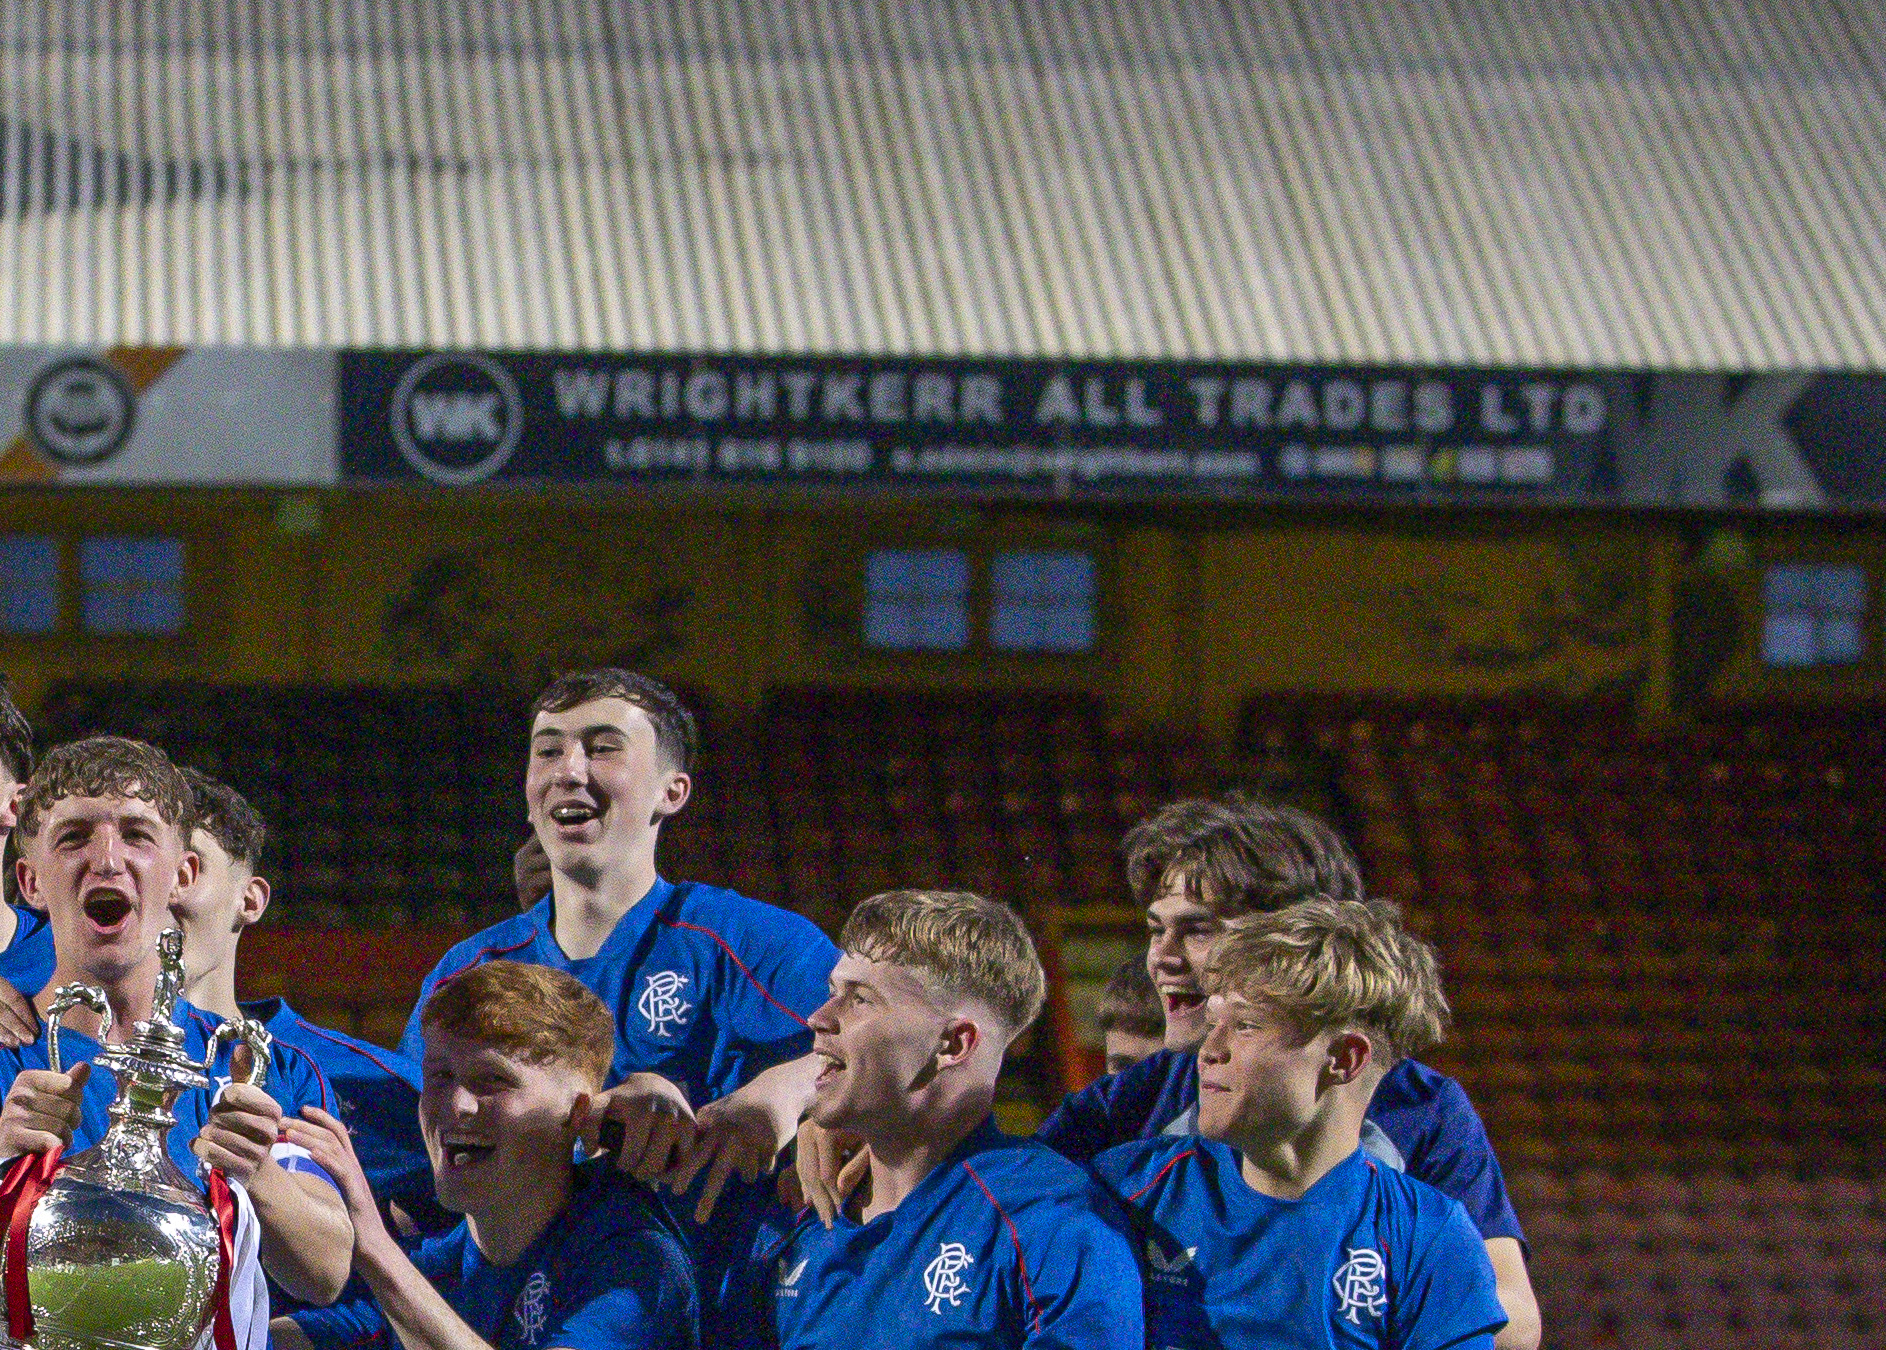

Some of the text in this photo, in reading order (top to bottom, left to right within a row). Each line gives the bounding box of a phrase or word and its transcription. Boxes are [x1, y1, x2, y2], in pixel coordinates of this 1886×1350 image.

[554, 368, 1606, 434] WRIGHTKERR ALL TRADES LTD
